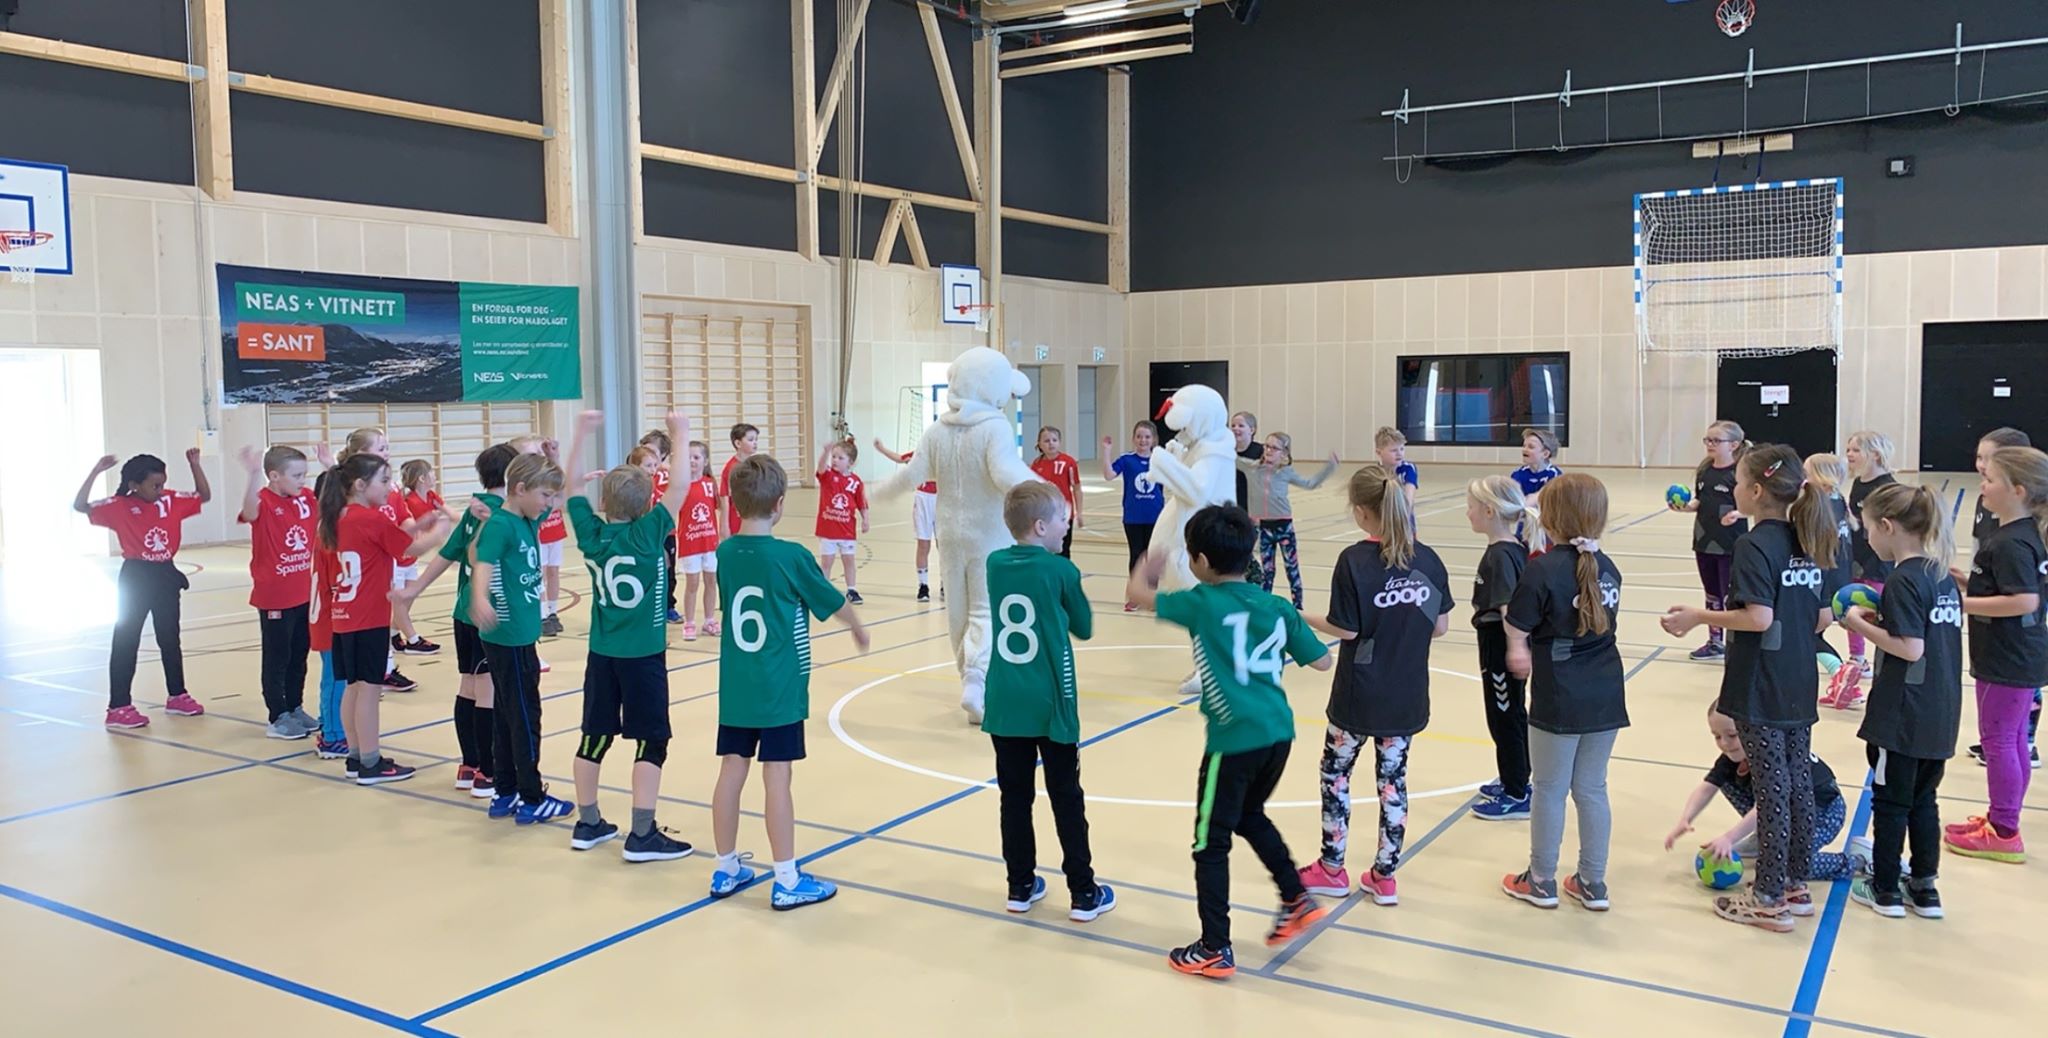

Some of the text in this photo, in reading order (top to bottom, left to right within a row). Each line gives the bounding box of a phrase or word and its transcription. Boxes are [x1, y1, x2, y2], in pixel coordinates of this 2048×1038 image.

[245, 291, 396, 316] NEAS + VITNETT
[472, 303, 483, 312] EN
[485, 304, 515, 313] FORDEL
[517, 305, 532, 314] FOR
[533, 306, 549, 314] DEG
[472, 315, 568, 326] EN SEIER FOR NABOLAGET
[248, 332, 315, 352] = SANT
[473, 372, 505, 382] NEAS
[1053, 461, 1066, 475] 17
[702, 481, 714, 498] 13
[154, 495, 172, 518] 17
[293, 496, 311, 519] 15
[584, 555, 644, 609] 16
[1385, 576, 1424, 591] team
[1373, 586, 1430, 608] coop
[731, 585, 767, 652] 6
[997, 593, 1038, 664] 8
[1222, 611, 1287, 688] 14
